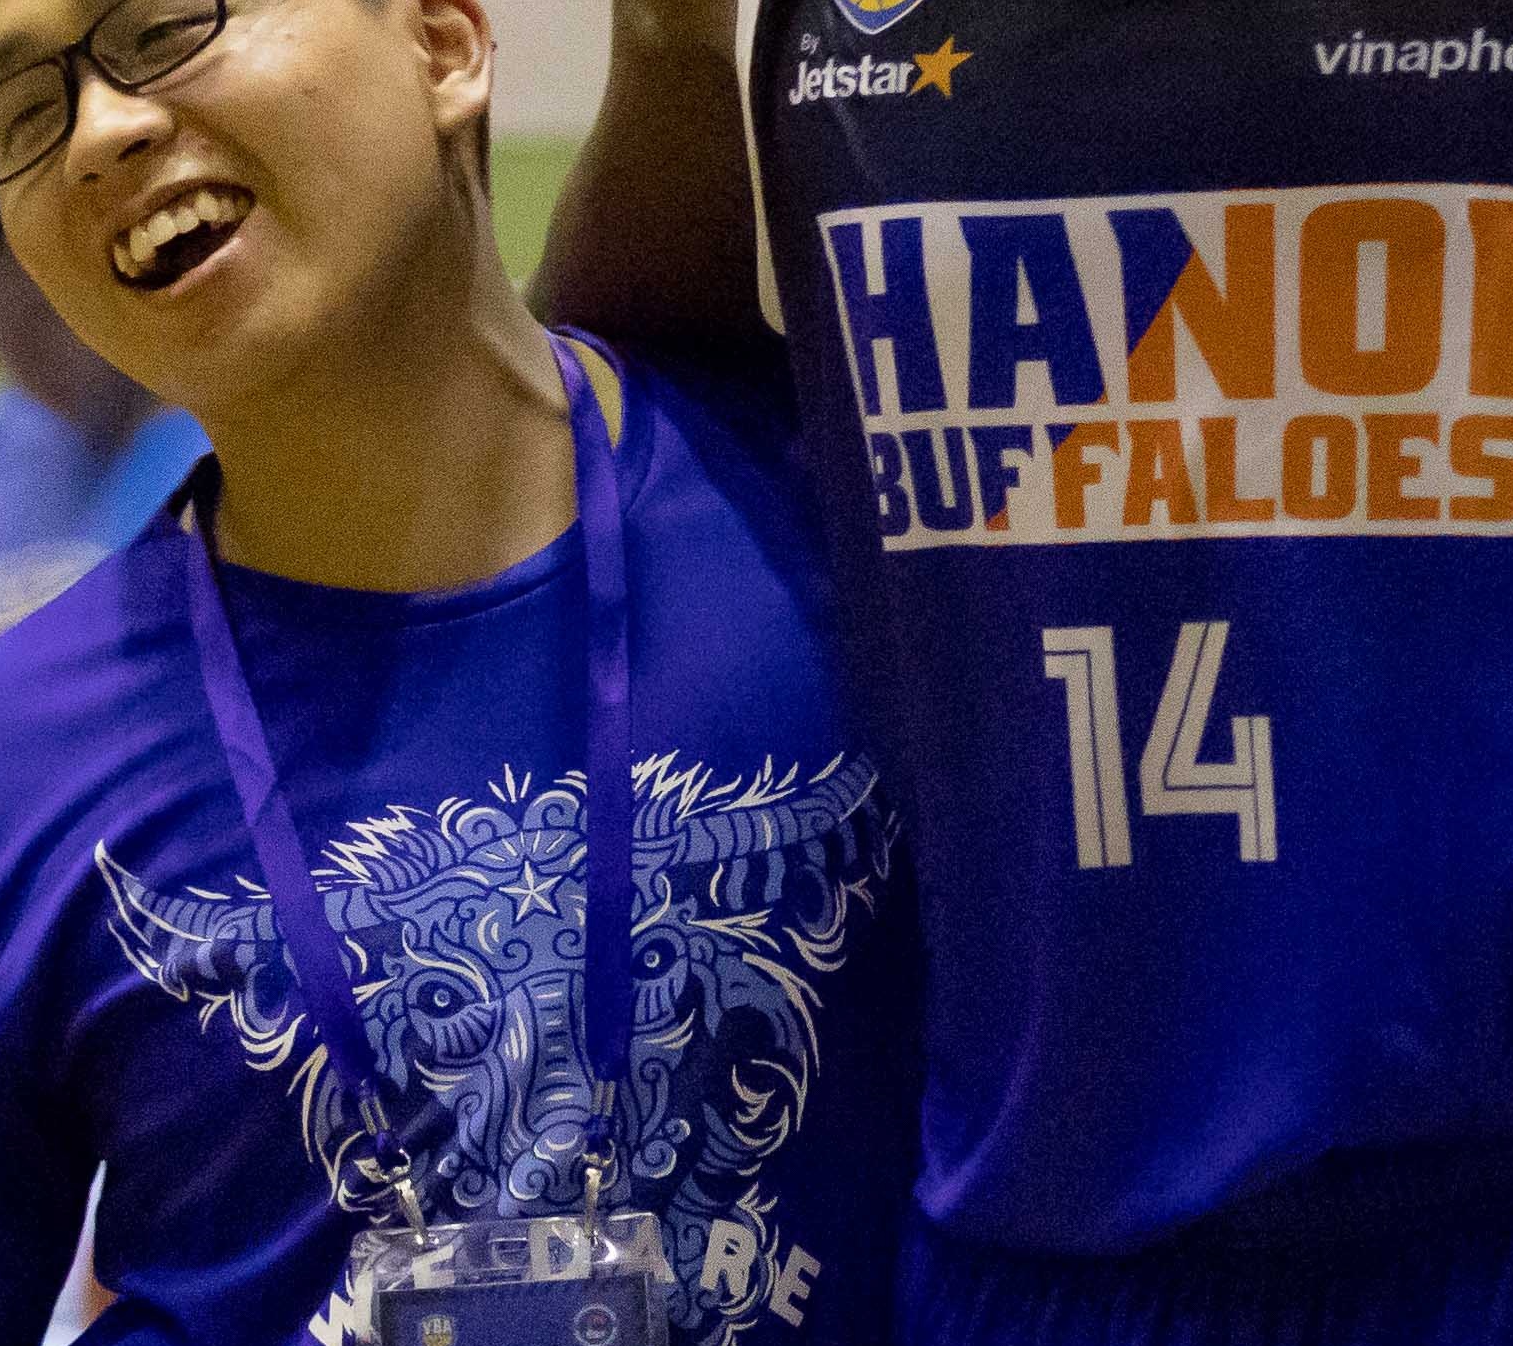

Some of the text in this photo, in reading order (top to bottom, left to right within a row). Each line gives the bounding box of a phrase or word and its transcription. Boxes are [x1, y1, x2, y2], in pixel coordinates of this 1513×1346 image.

[799, 32, 820, 56] By
[789, 55, 916, 105] Jetstar
[1042, 621, 1277, 869] 14
